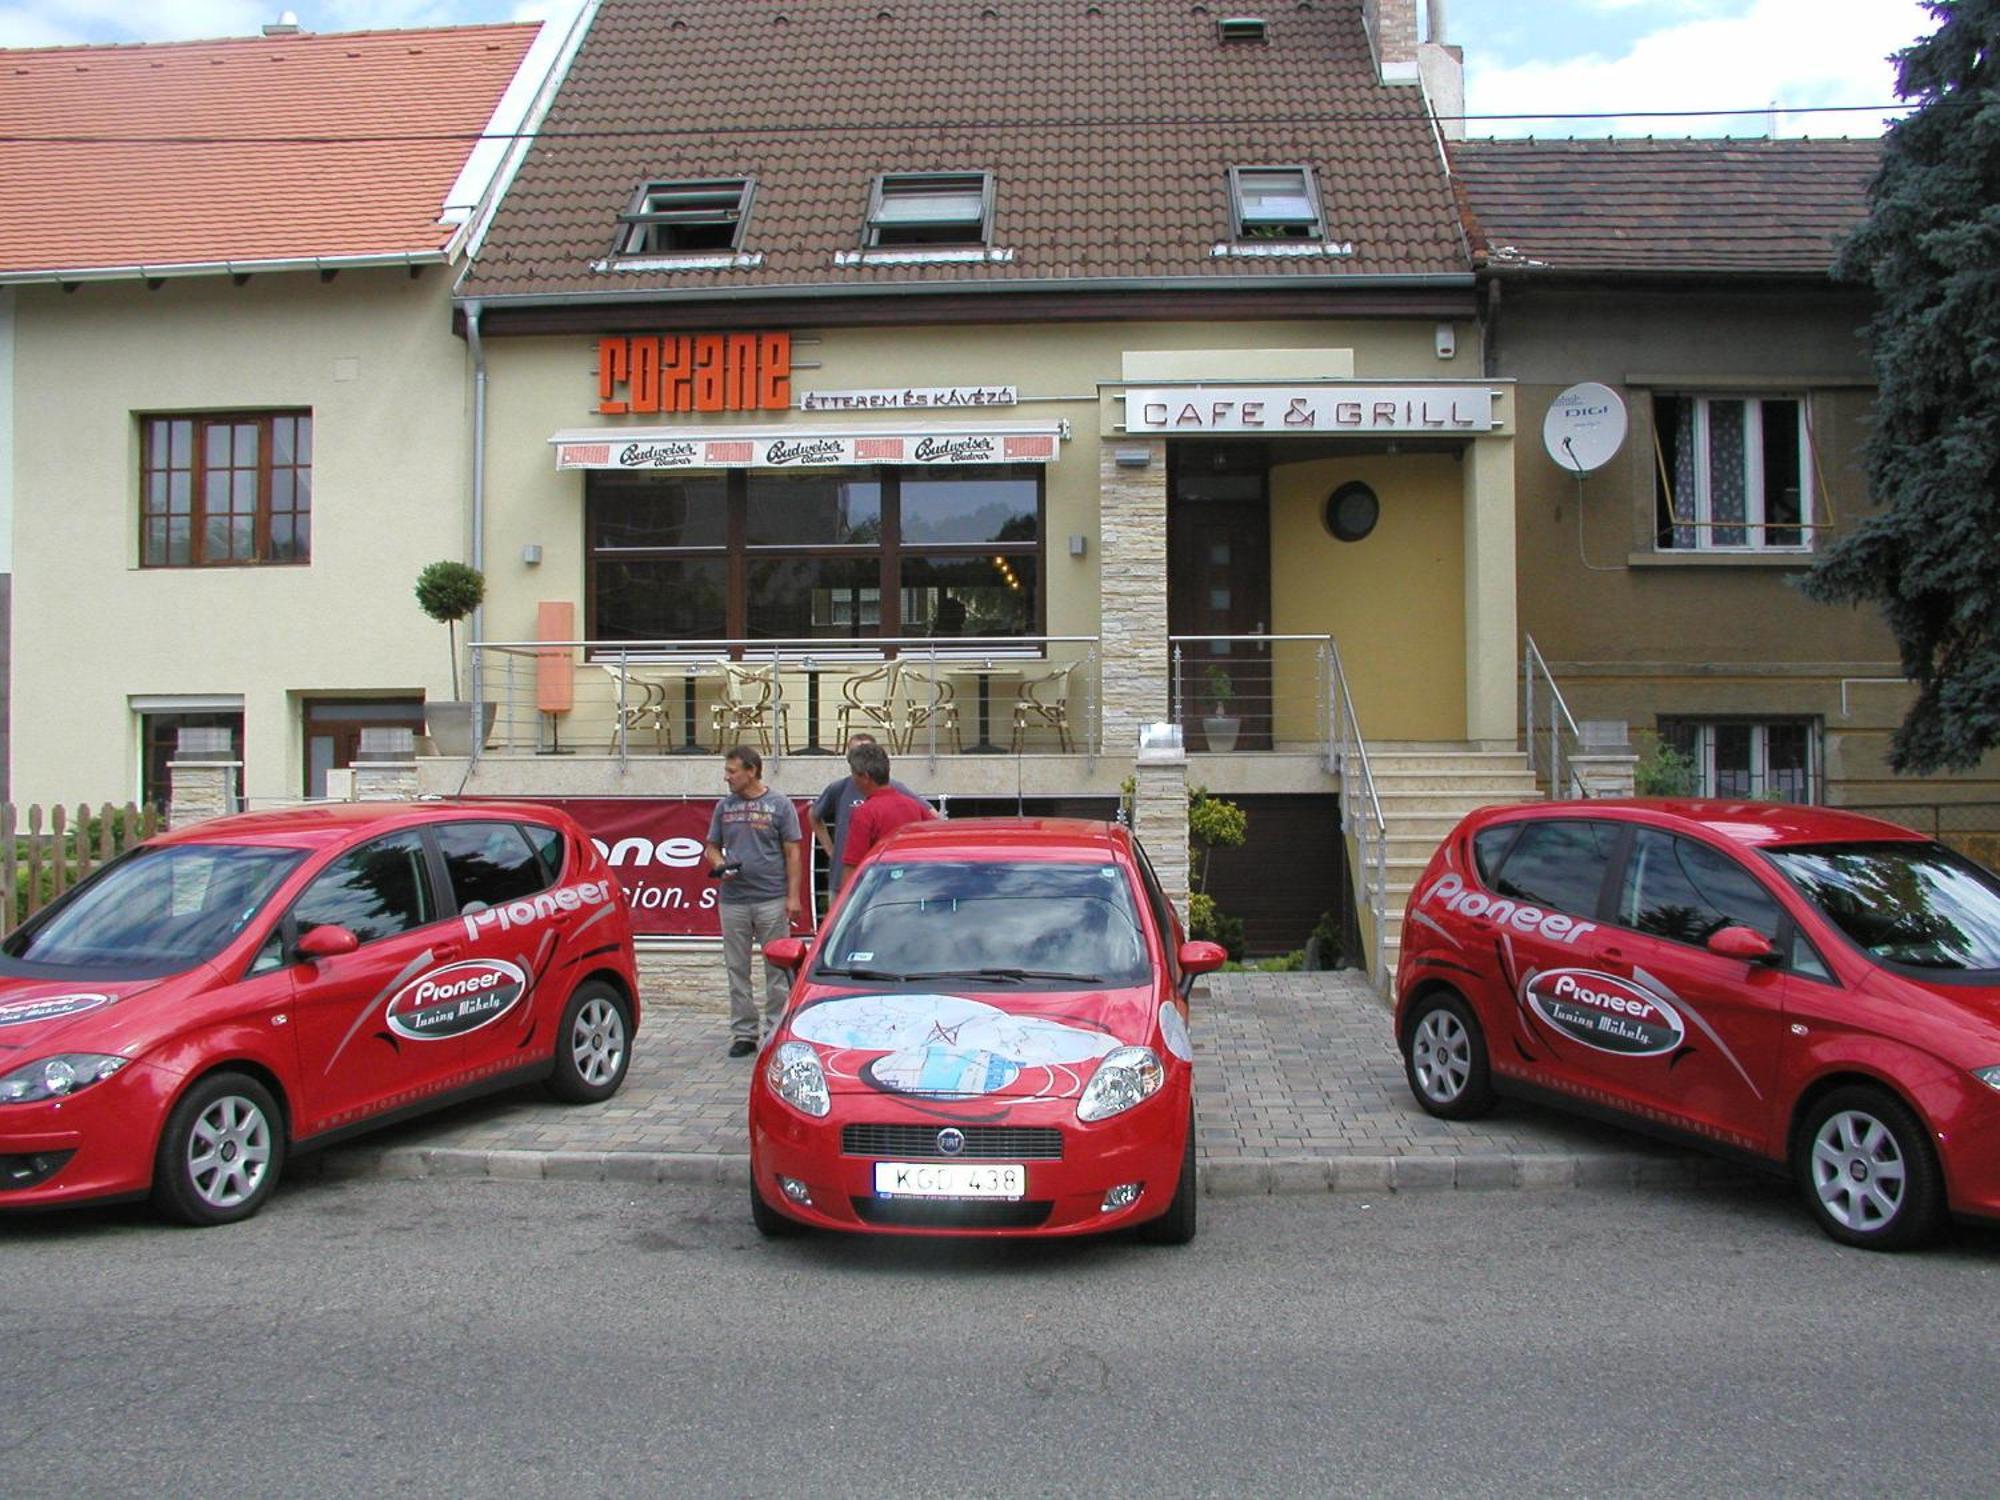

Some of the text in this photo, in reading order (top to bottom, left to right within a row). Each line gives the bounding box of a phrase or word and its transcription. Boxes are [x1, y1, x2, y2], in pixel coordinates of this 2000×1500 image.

[805, 387, 1014, 409] ÉTTEREM ÉS KÁVÉZÓ
[1144, 398, 1474, 427] CAFE & GRILL
[620, 443, 696, 466] Budweiser
[766, 440, 845, 464] Budweiser
[915, 437, 994, 462] Budweiser
[622, 881, 690, 909] ion.
[1420, 872, 1597, 944] Pioneer
[461, 880, 609, 941] Pioneer
[415, 972, 502, 1006] Pioneer
[1554, 976, 1653, 1017] Pioneer
[409, 1010, 455, 1028] Tuning
[1549, 1001, 1593, 1029] Tuning
[968, 1170, 1017, 1192] 438
